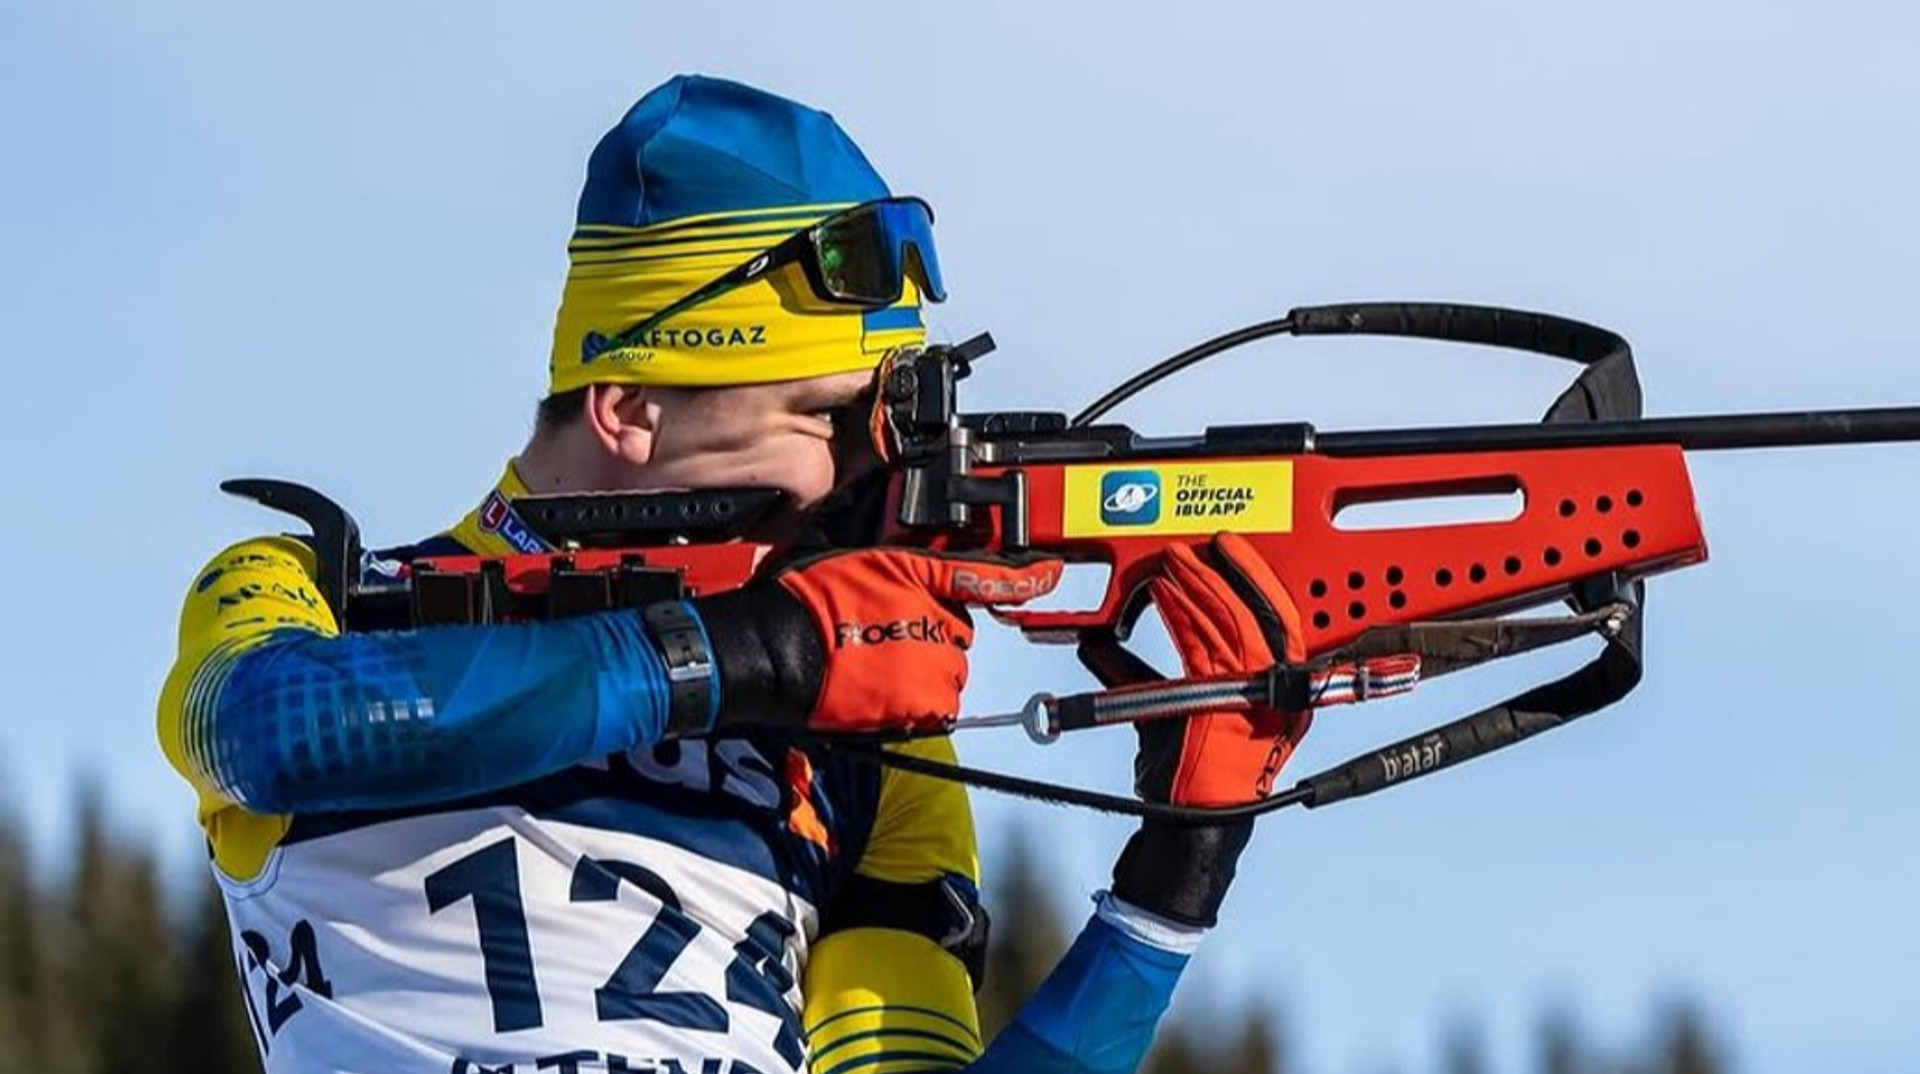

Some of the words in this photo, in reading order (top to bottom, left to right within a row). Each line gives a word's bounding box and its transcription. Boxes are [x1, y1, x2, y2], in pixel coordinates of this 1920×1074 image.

[1176, 474, 1207, 487] THE
[1175, 488, 1254, 502] OFFICIAL
[1175, 503, 1206, 517] IBU
[1208, 502, 1246, 516] APP
[503, 518, 545, 554] LAP
[424, 835, 808, 1072] 124
